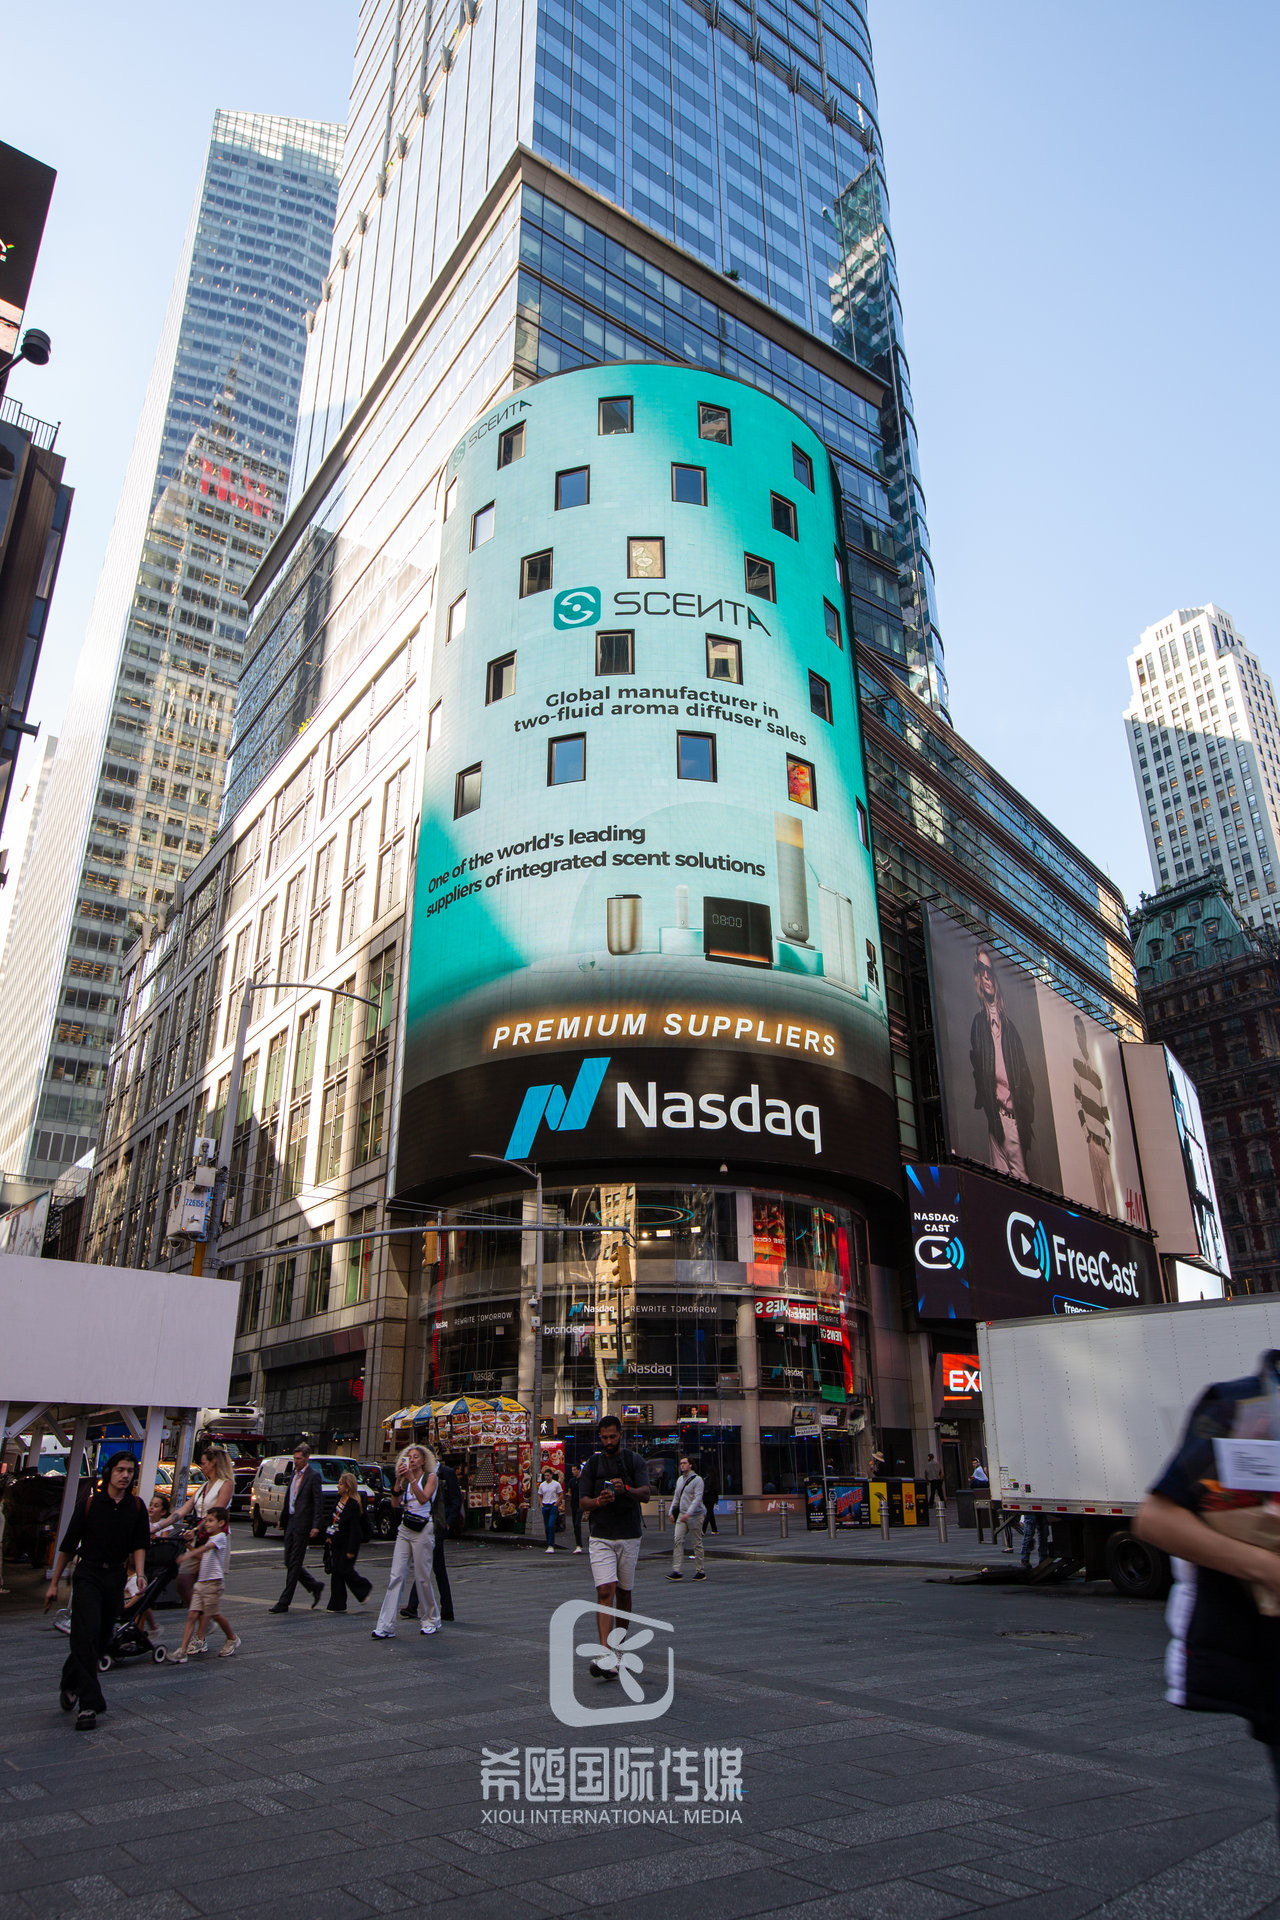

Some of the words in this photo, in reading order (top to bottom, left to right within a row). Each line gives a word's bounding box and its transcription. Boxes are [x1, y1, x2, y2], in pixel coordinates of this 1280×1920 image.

[546, 686, 610, 707] Global
[618, 686, 757, 712] manufacturer
[763, 701, 779, 720] in
[514, 702, 603, 732] two-fluid
[611, 703, 679, 715] aroma
[686, 703, 761, 729] diffuser
[766, 721, 807, 746] sales
[428, 871, 449, 893] One
[452, 858, 467, 879] of
[468, 851, 493, 871] the
[497, 833, 564, 860] world's
[569, 825, 646, 845] leading
[426, 878, 482, 918] suppliers
[485, 868, 503, 888] of
[505, 850, 607, 882] integrated
[612, 851, 670, 866] scent
[675, 852, 766, 877] solutions
[712, 913, 743, 928] 08:00
[493, 1013, 647, 1050] PREMIUM
[663, 1013, 837, 1056] SUPPLIERS
[616, 1082, 823, 1155] Nasdaq
[913, 1212, 959, 1223] NASDAQ:
[1125, 1187, 1144, 1227] H&M
[924, 1224, 950, 1232] CAST
[1052, 1234, 1140, 1298] FreeCast
[477, 1312, 513, 1322] TOMORROW
[583, 1304, 615, 1315] Nasdaq
[630, 1305, 667, 1313] REWRITE
[628, 1363, 672, 1376] Nasdaq
[949, 1370, 982, 1392] EX
[837, 1488, 863, 1514] AMAZE
